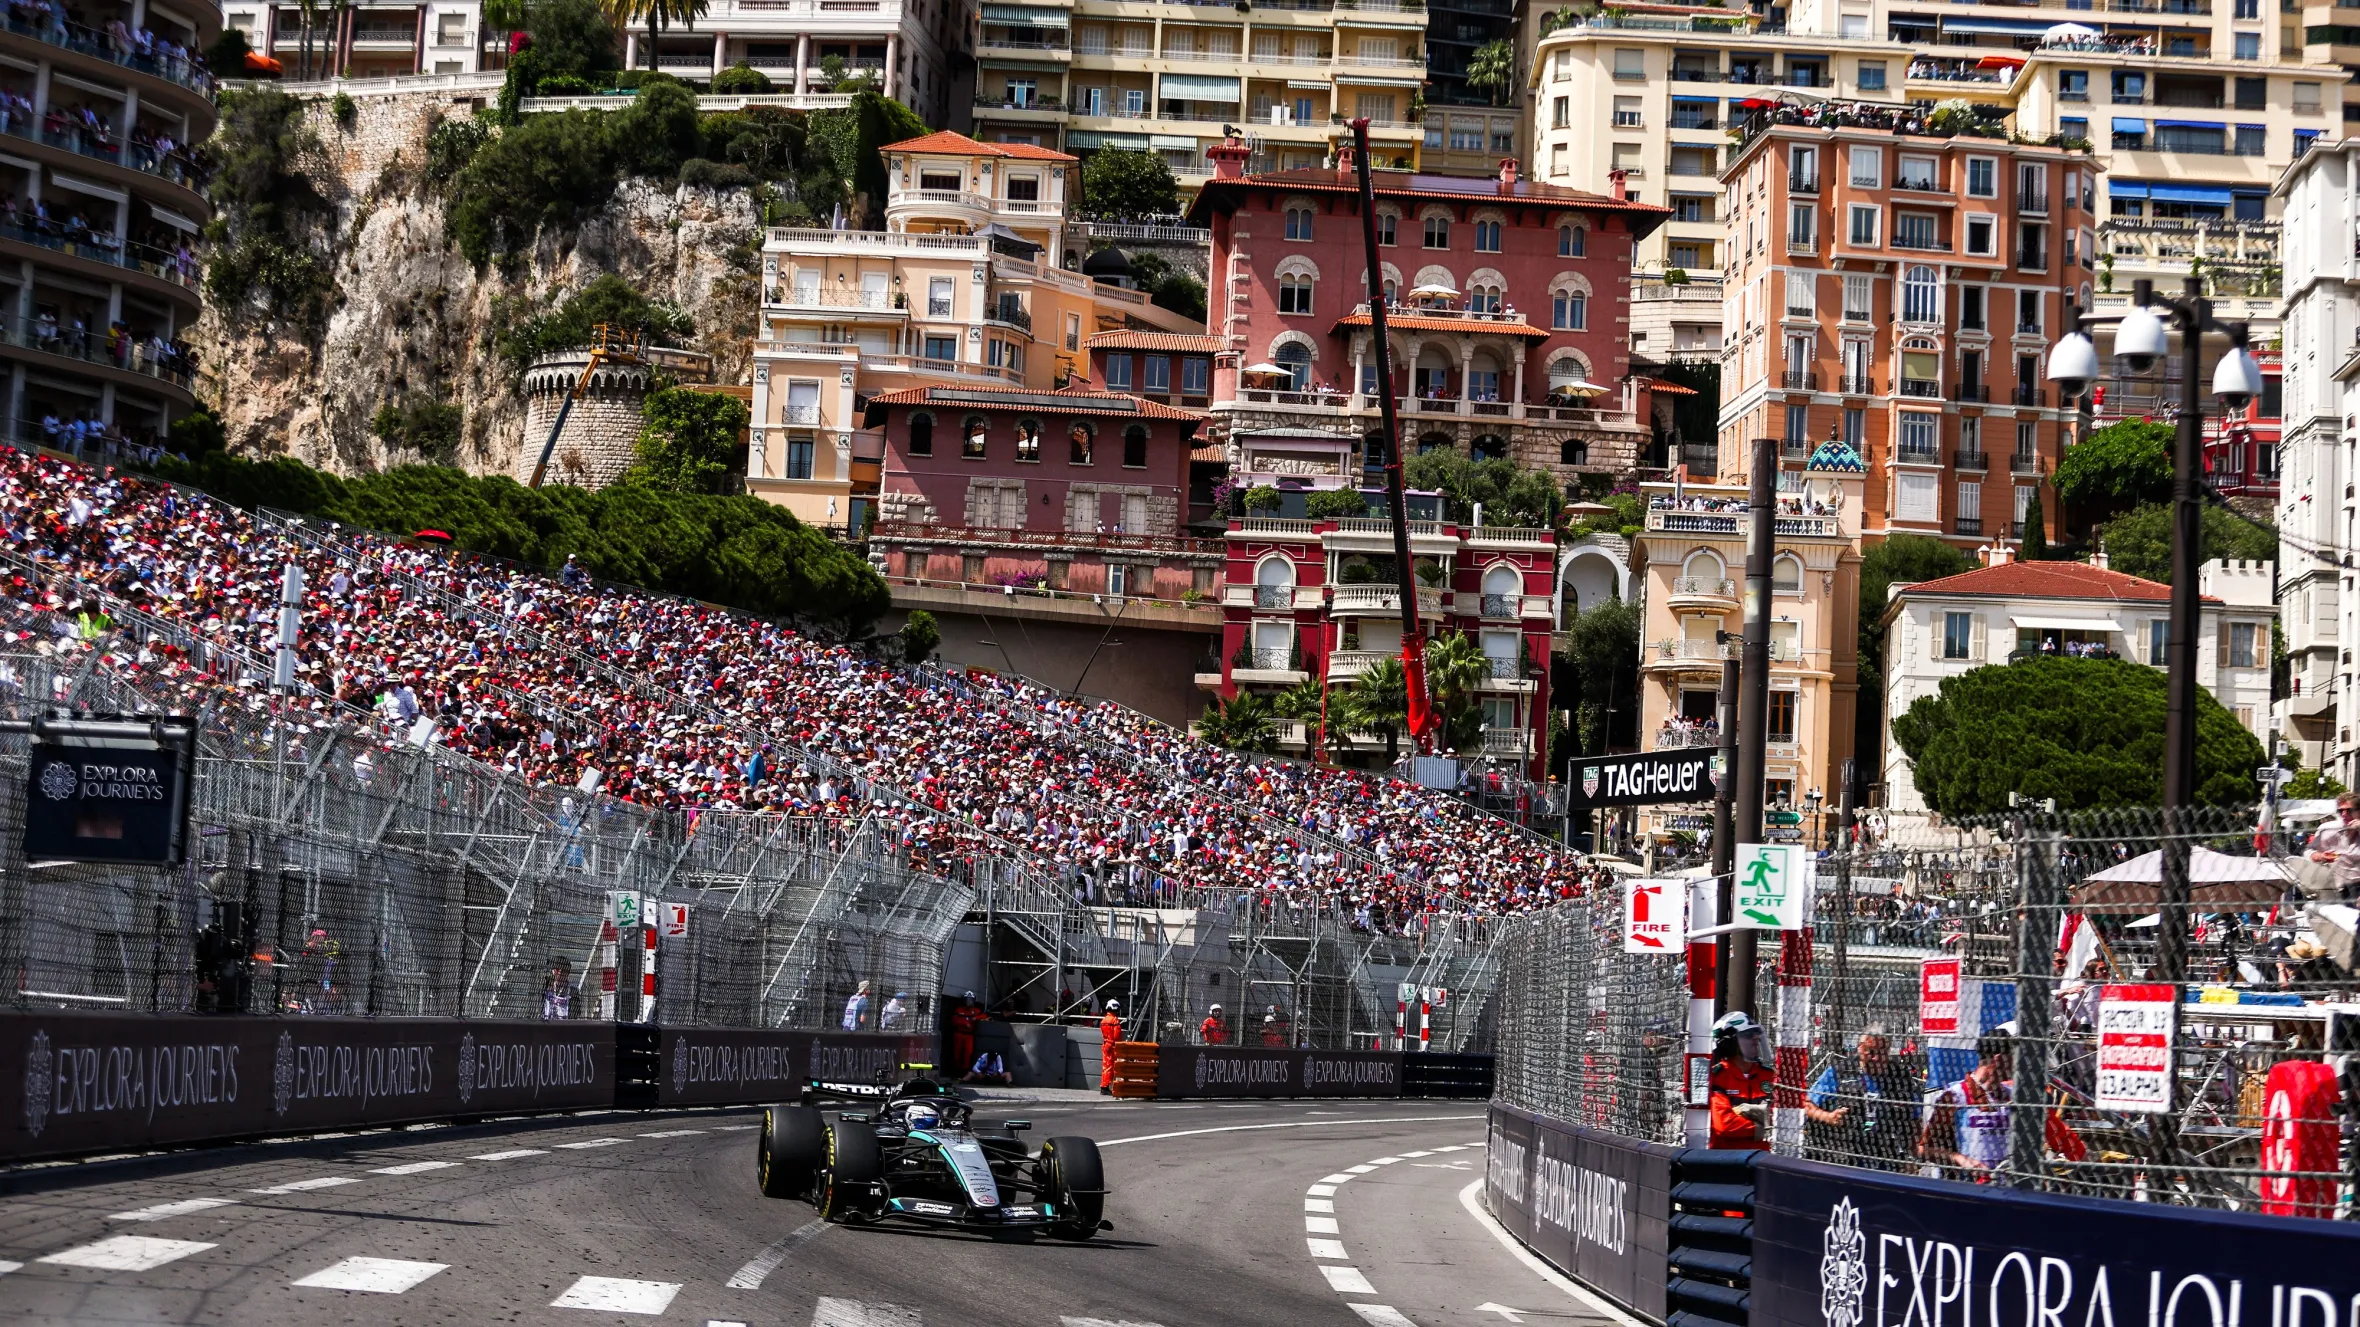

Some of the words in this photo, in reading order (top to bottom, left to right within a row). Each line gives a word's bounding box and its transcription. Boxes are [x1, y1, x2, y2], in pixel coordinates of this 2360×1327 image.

[83, 765, 158, 783] EXPLORA
[1585, 769, 1598, 779] TAG
[80, 782, 164, 800] JOURNEYS
[1740, 897, 1785, 907] EXIT
[1632, 924, 1671, 932] FIRE
[297, 1046, 360, 1099] EXPLORA
[362, 1046, 433, 1111] JOURNEYS
[478, 1044, 533, 1089] EXPLORA
[533, 1043, 595, 1100] JOURNEYS
[689, 1046, 738, 1082] EXPLORA
[739, 1046, 790, 1091] JOURNEYS
[1207, 1059, 1246, 1083] EXPLORA
[1247, 1059, 1289, 1088] JOURNEYS
[1315, 1060, 1352, 1083] EXPLORA
[1353, 1061, 1394, 1088] JOURNEYS
[56, 1046, 145, 1114] EXPLORA
[148, 1045, 240, 1126] JOURNEYS
[1543, 1157, 1577, 1233] EXPLORA
[1575, 1167, 1627, 1256] JOURNEYS
